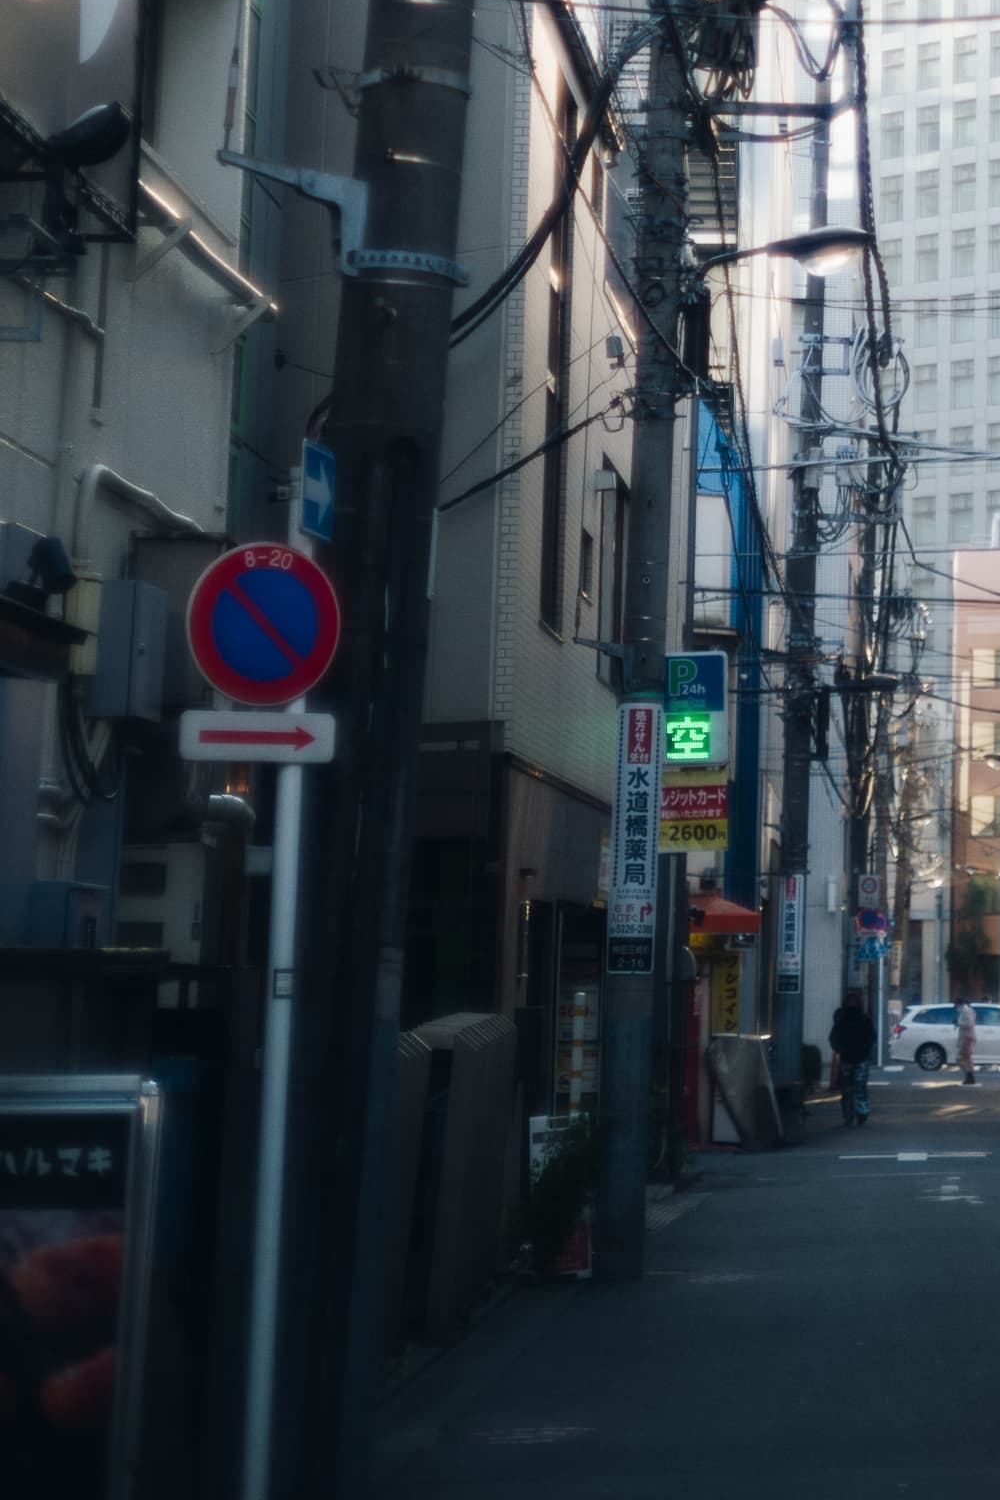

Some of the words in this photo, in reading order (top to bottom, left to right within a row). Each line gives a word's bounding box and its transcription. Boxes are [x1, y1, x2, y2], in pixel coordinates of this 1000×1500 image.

[245, 549, 293, 571] 8-20
[669, 658, 698, 697] P
[681, 683, 706, 697] 24h
[633, 710, 648, 753] 処方せん
[667, 716, 710, 760] 空
[624, 767, 650, 886] 水道橋薬局
